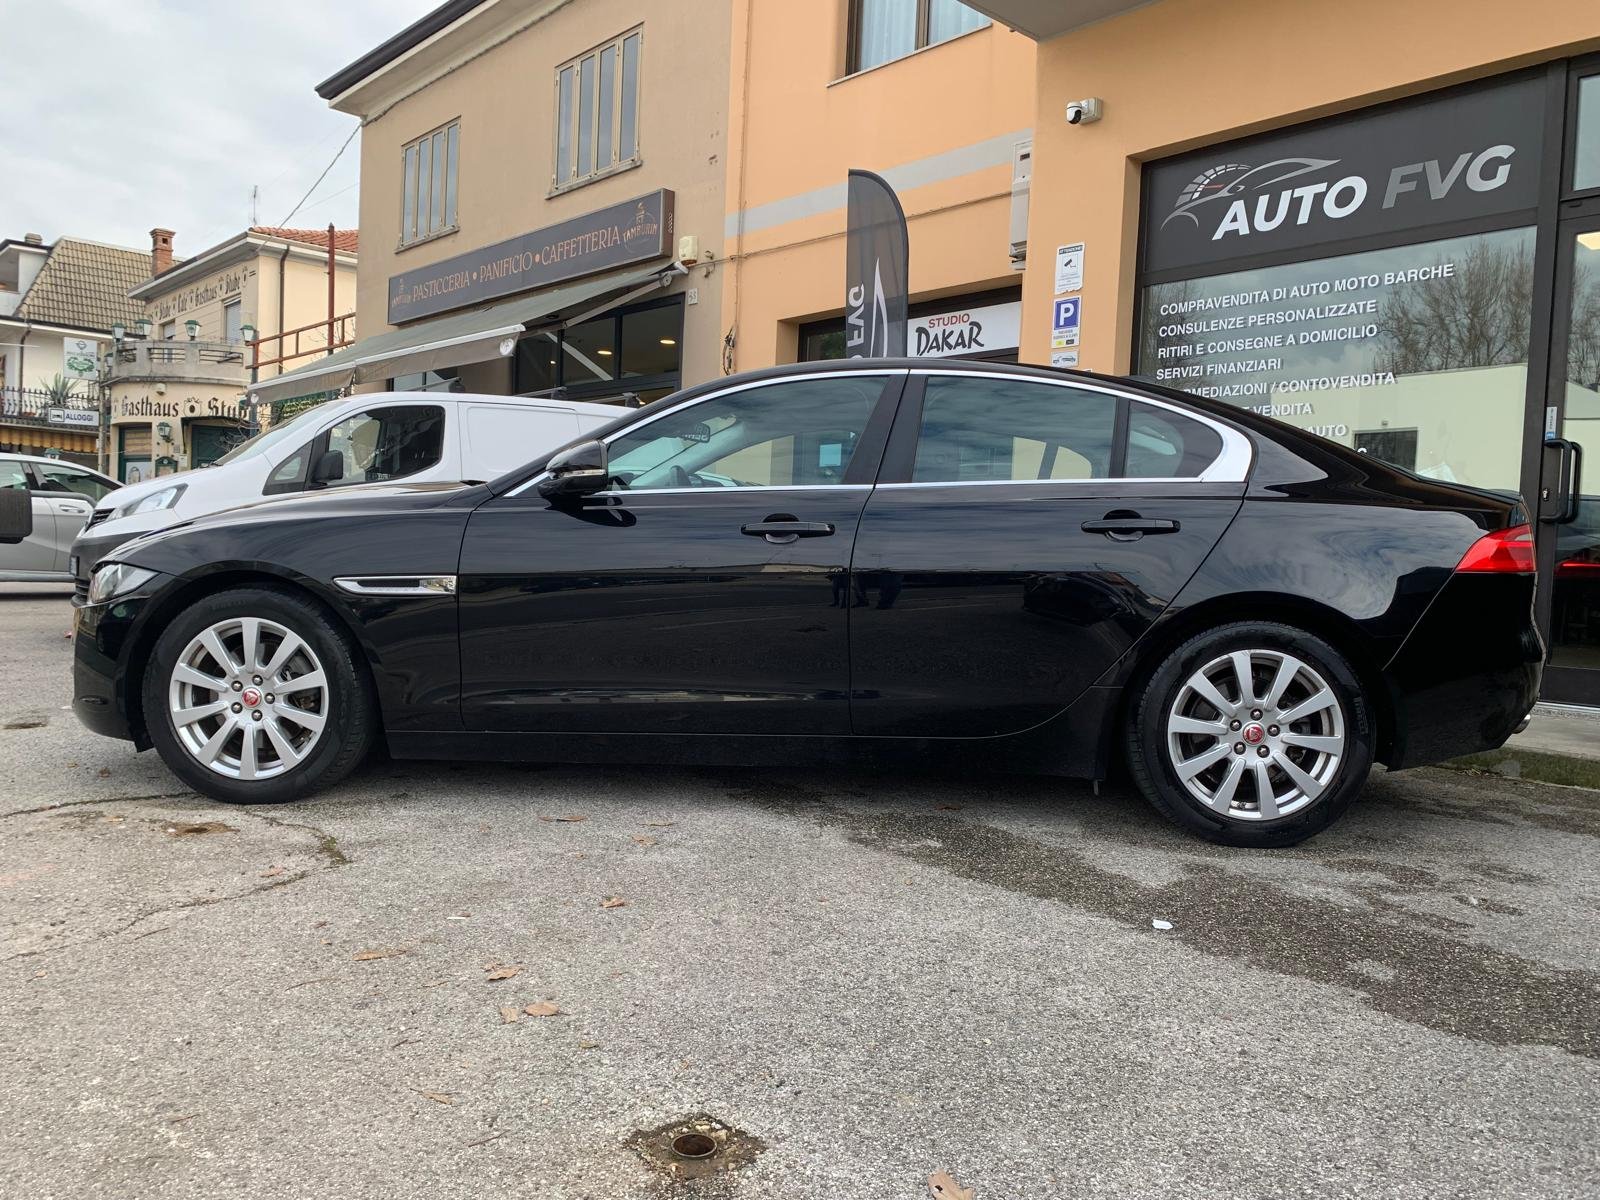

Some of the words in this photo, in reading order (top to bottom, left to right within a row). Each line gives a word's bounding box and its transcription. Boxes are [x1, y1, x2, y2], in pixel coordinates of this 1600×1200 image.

[1212, 175, 1368, 241] AUTO
[1382, 144, 1516, 210] FVG
[412, 270, 470, 302] PASTICCERIA
[479, 251, 533, 283] PANIFICIO
[541, 226, 620, 266] CAFFETTERIA
[1160, 290, 1270, 316] COMPRAVENDITA
[1273, 287, 1287, 300] DI
[1290, 281, 1330, 298] AUTO
[1334, 274, 1379, 292] MOTO
[1384, 263, 1454, 285] BARCHE
[928, 313, 970, 329] STUDIO
[1059, 302, 1075, 326] P
[1159, 316, 1244, 337] CONSULENZE
[1248, 299, 1377, 327] PERSONALIZZATE
[915, 321, 984, 356] DAKAR
[1158, 345, 1193, 359] RITIRI
[1196, 343, 1205, 355] E
[1207, 335, 1283, 354] CONSEGNE
[1286, 333, 1296, 346] A
[1299, 324, 1378, 344] DOMICILIO
[1156, 365, 1203, 380] SERVIZI
[1207, 358, 1281, 376] FINANZIARI
[1279, 371, 1396, 392] CONTOVENDITA
[65, 412, 94, 422] ALLOGGI
[122, 395, 179, 418] Gasthaus
[1253, 403, 1312, 417] VENDITA
